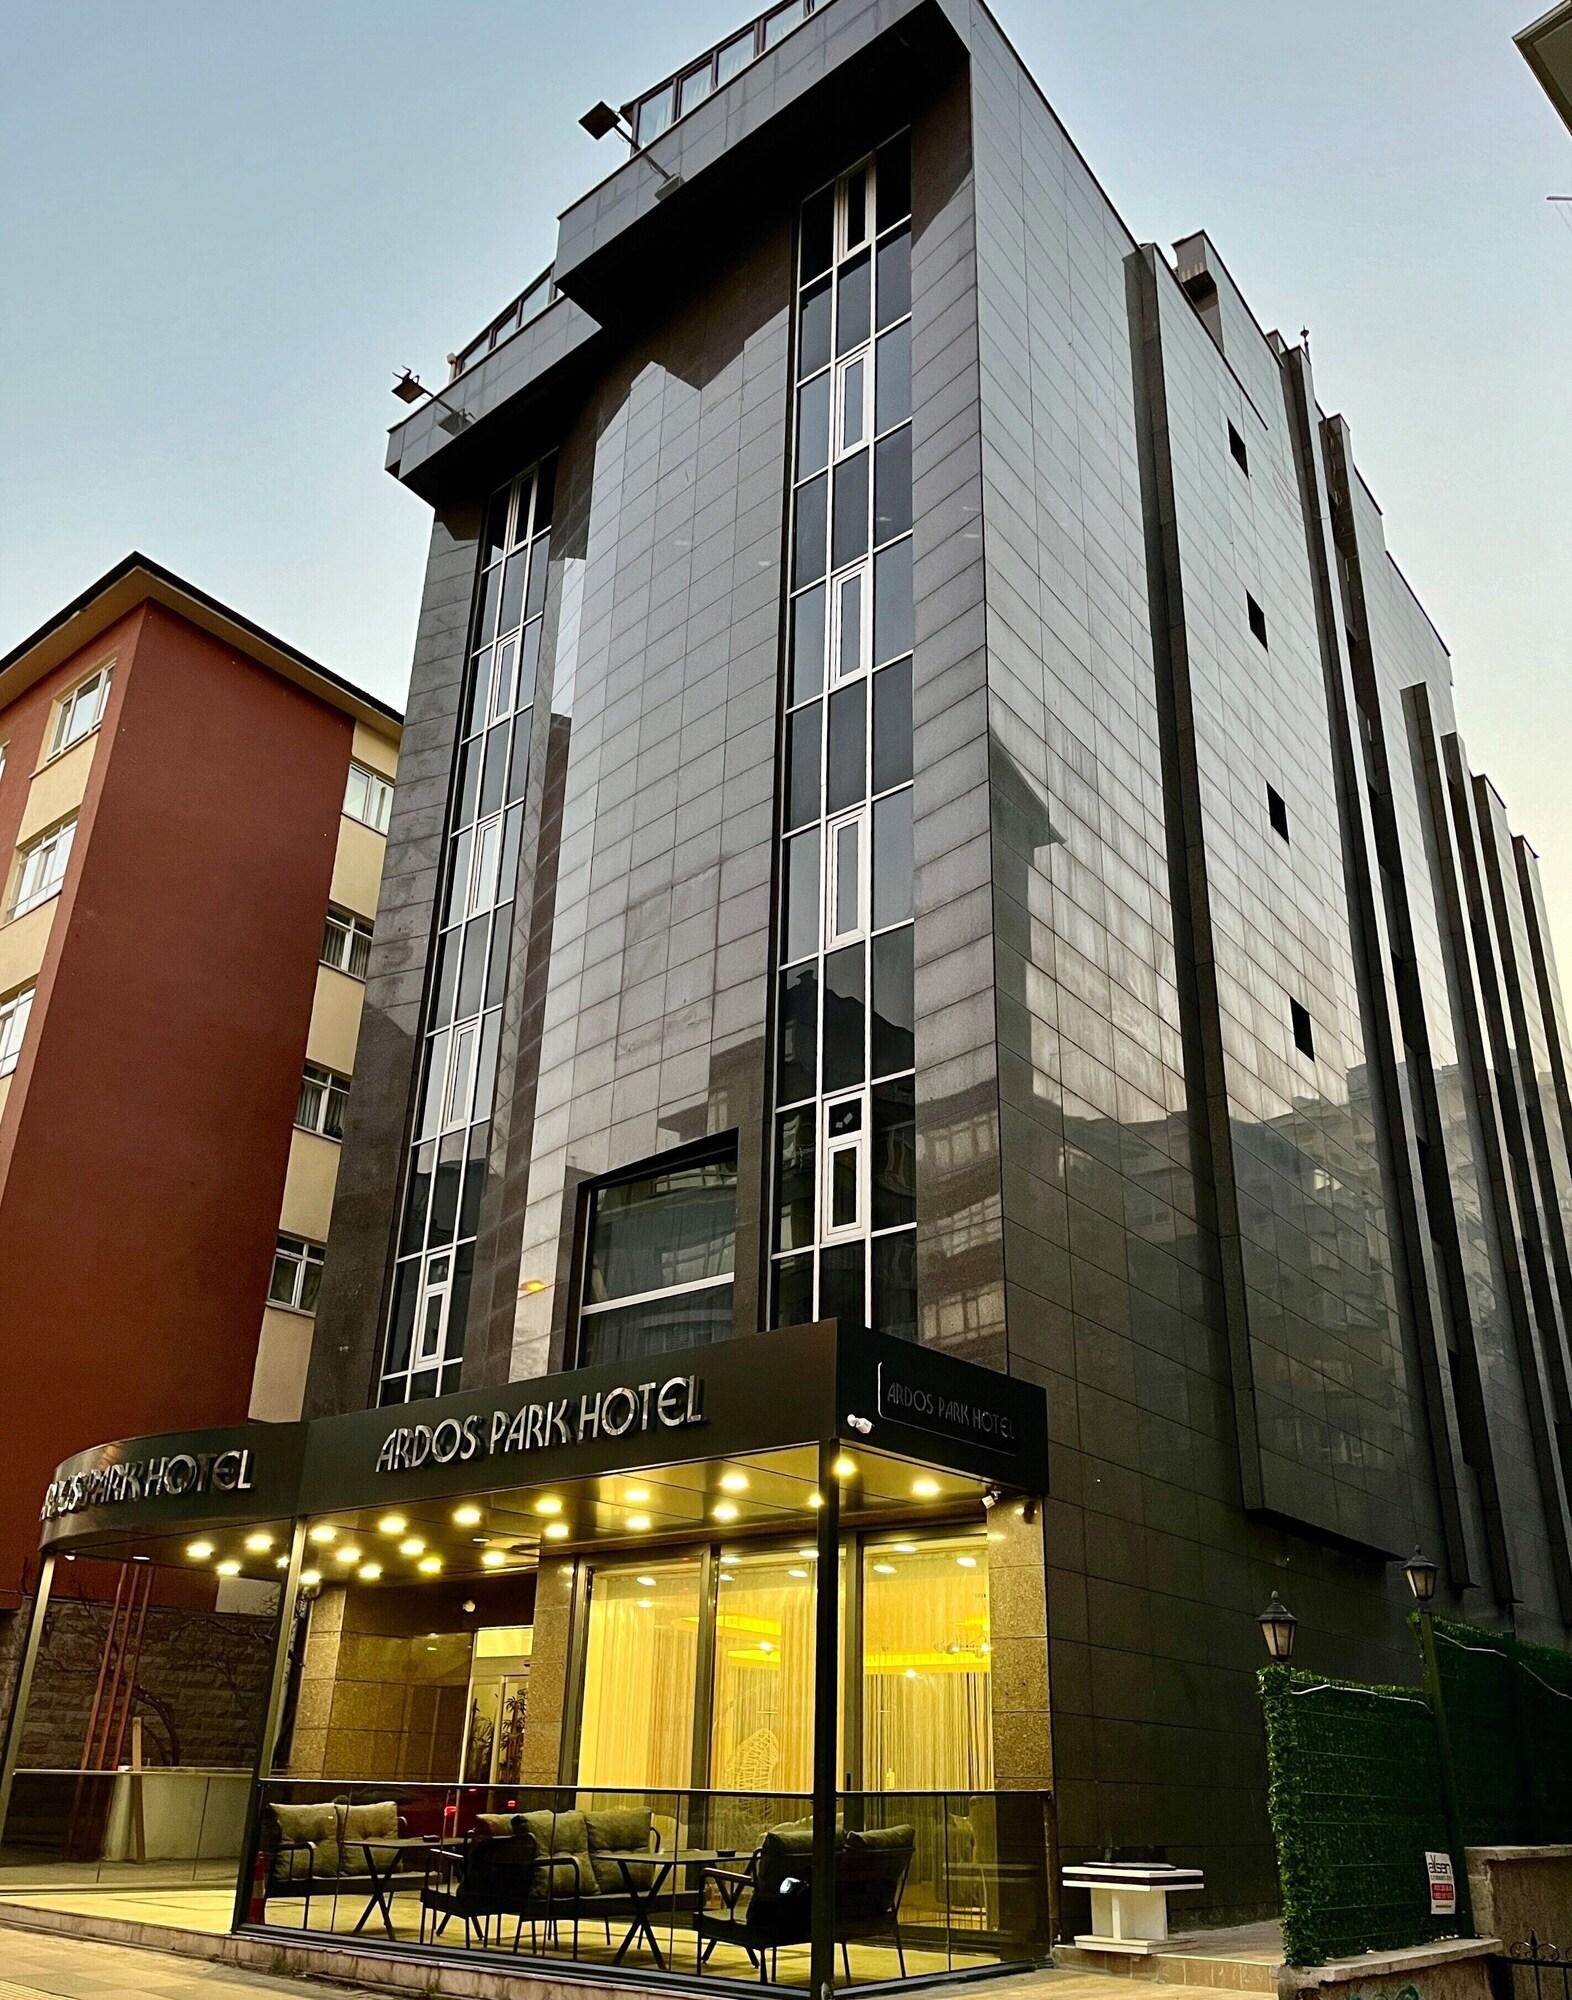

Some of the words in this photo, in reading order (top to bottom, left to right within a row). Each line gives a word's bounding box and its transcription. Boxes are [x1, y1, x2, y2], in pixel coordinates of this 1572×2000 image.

[375, 1415, 481, 1472] ARDOS
[489, 1399, 568, 1454] PARK
[578, 1374, 703, 1441] HOTEL
[887, 1382, 933, 1415] ARDOS
[938, 1396, 970, 1426] PARK
[972, 1407, 1016, 1440] HOTEL
[88, 1461, 142, 1504] PARK
[145, 1450, 253, 1497] HOTEL
